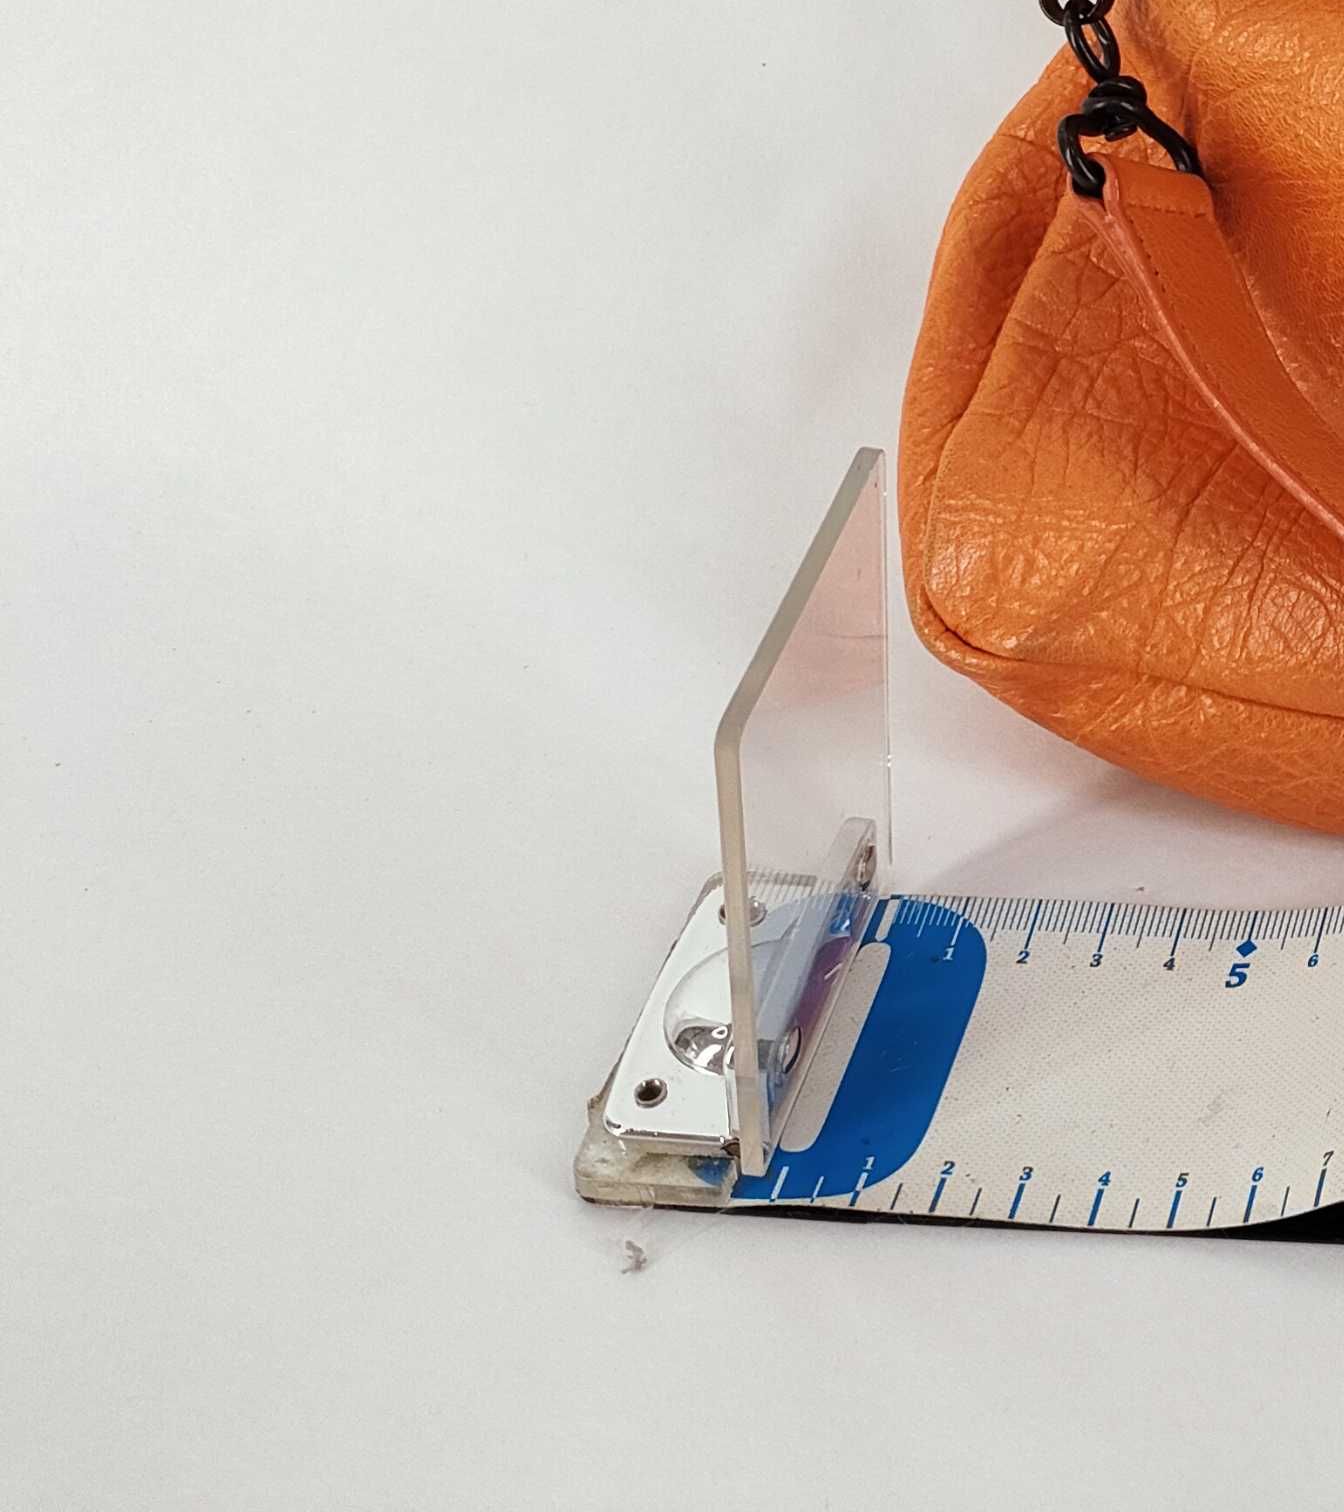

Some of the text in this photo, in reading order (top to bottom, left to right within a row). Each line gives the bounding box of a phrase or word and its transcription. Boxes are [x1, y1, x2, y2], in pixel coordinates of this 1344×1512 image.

[942, 947, 956, 961] 1
[1016, 950, 1031, 964] 2
[1090, 954, 1103, 968] 3
[1163, 957, 1177, 970] 4
[1225, 964, 1250, 988] 5
[1307, 954, 1319, 967] 6
[861, 1156, 876, 1169] 1
[940, 1161, 955, 1175] 2
[1018, 1167, 1033, 1182] 3
[1097, 1171, 1111, 1186] 4
[1175, 1173, 1190, 1187] 5
[1251, 1166, 1264, 1182] 6
[1321, 1151, 1334, 1166] 7
